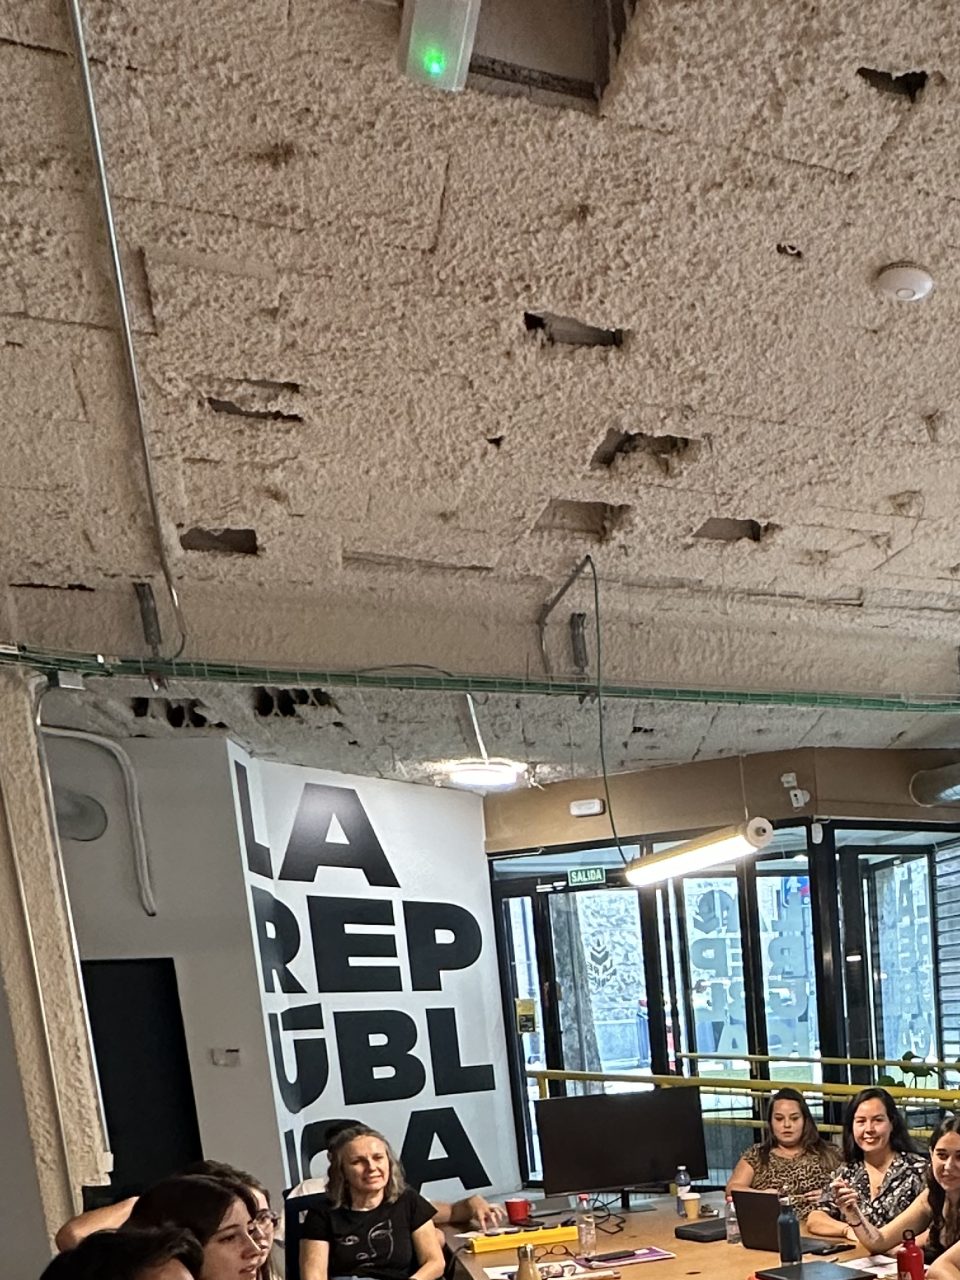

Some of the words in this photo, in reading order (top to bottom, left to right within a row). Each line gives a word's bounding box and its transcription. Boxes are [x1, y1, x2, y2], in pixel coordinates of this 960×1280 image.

[234, 760, 401, 888] LA
[571, 869, 602, 882] SALIDA
[250, 884, 483, 994] REP
